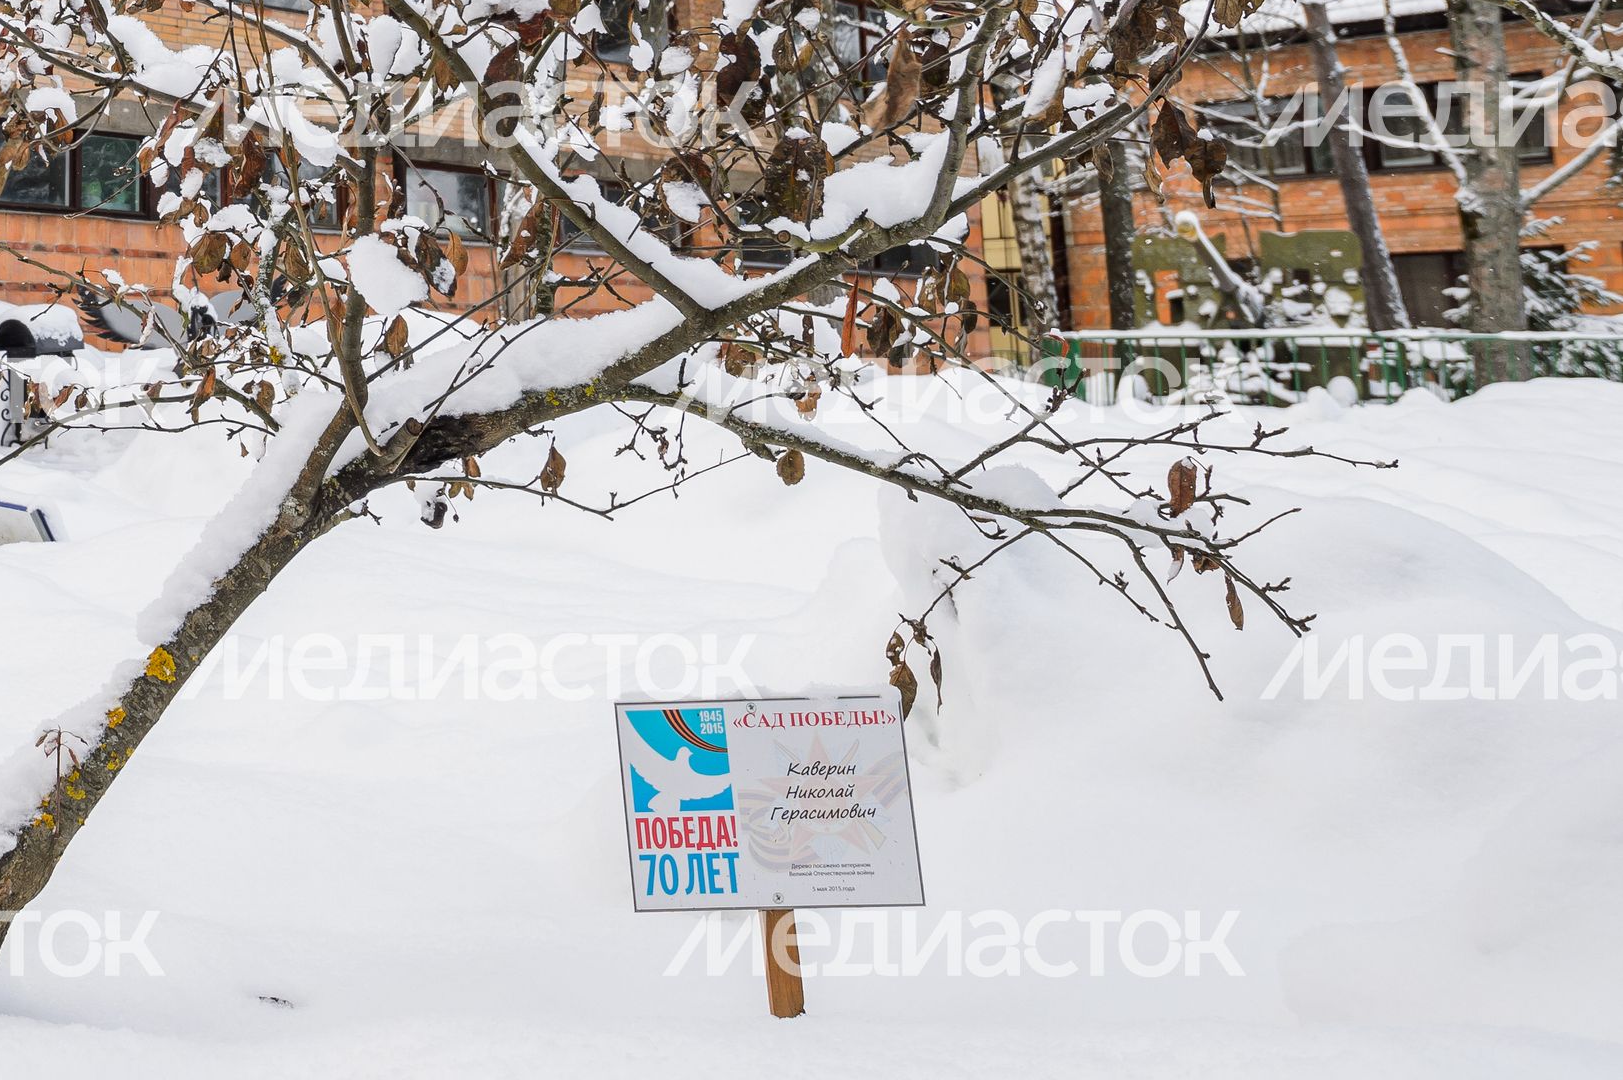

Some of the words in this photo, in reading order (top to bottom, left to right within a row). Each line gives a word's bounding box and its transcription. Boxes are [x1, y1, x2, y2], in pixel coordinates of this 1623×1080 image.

[699, 710, 722, 722] 1945
[733, 711, 786, 731] «САД
[790, 709, 896, 729] ПОБЕДЫ!»
[700, 722, 724, 734] 2015
[786, 760, 856, 779] Каверин
[786, 783, 853, 800] Николай
[769, 805, 876, 824] Герасимович
[635, 816, 738, 850] ПОБЕДА!
[639, 854, 681, 895] 70
[685, 852, 739, 895] ЛЕТ
